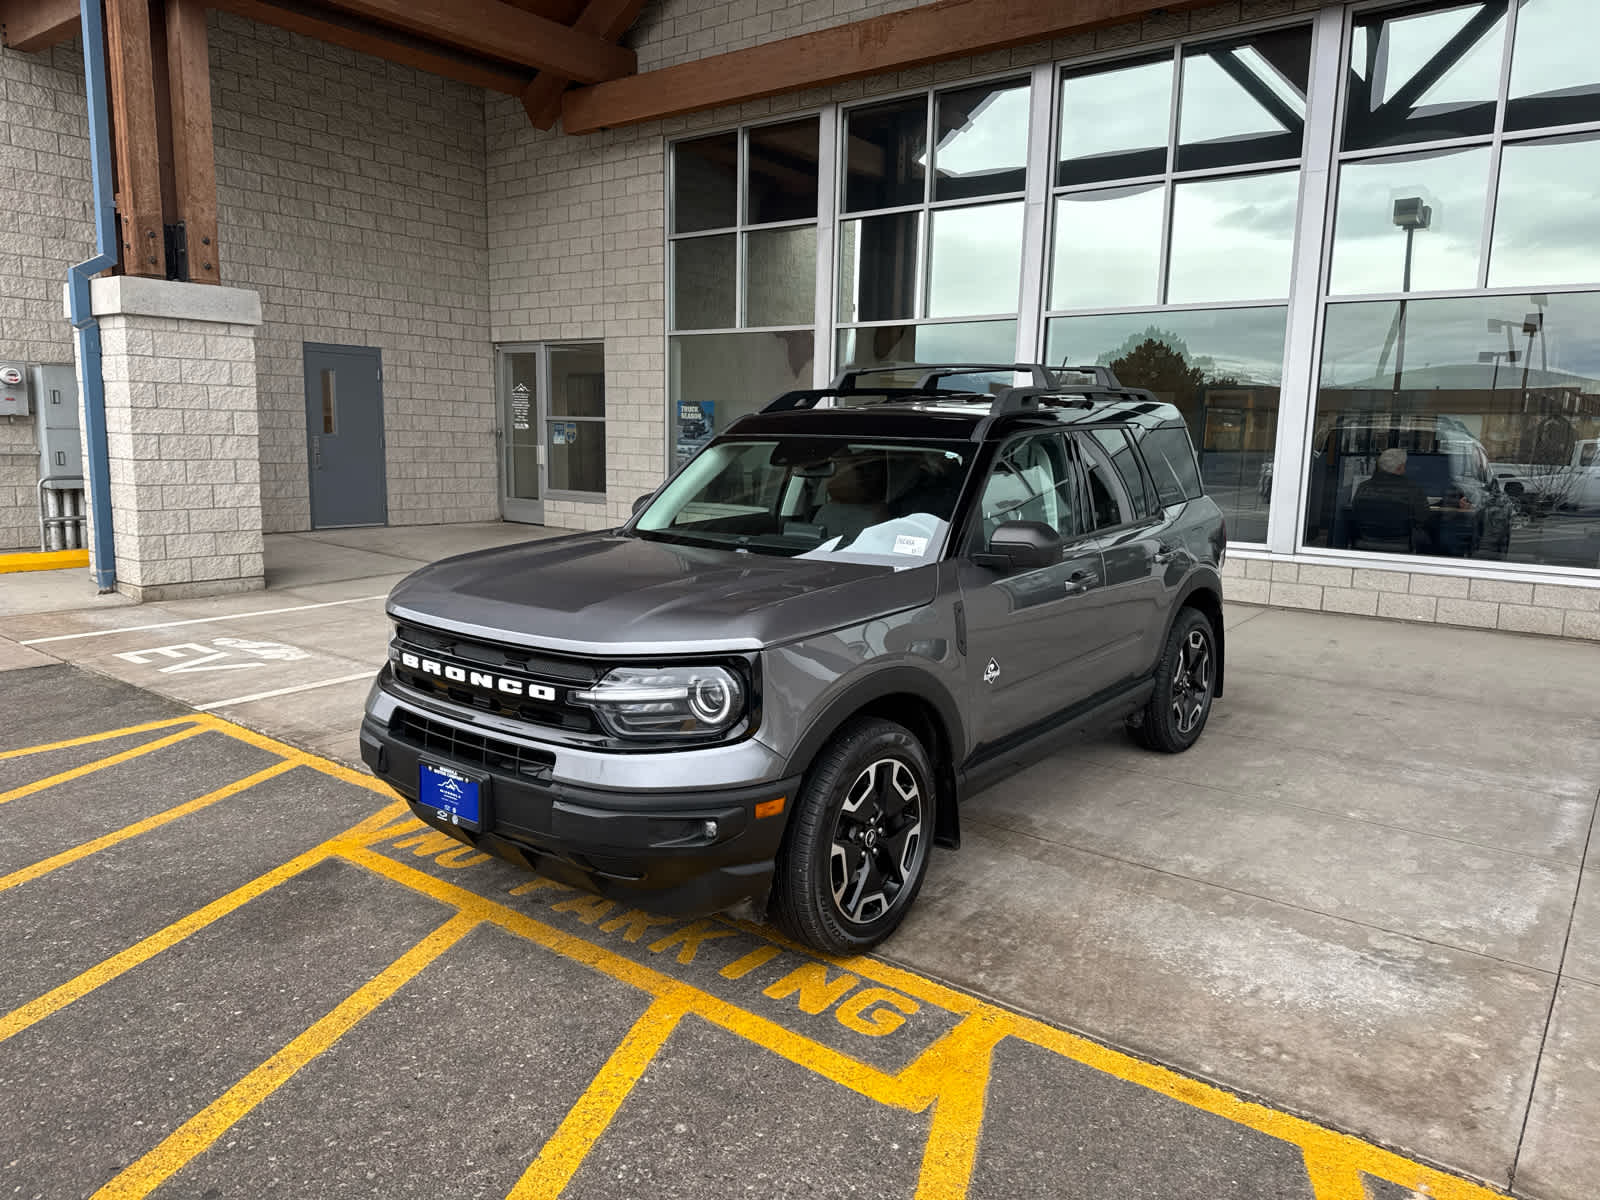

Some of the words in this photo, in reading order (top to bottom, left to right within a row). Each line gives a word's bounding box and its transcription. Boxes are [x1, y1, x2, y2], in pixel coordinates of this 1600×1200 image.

[112, 642, 267, 674] EV
[402, 652, 556, 701] BRONCO
[391, 831, 494, 869] NO
